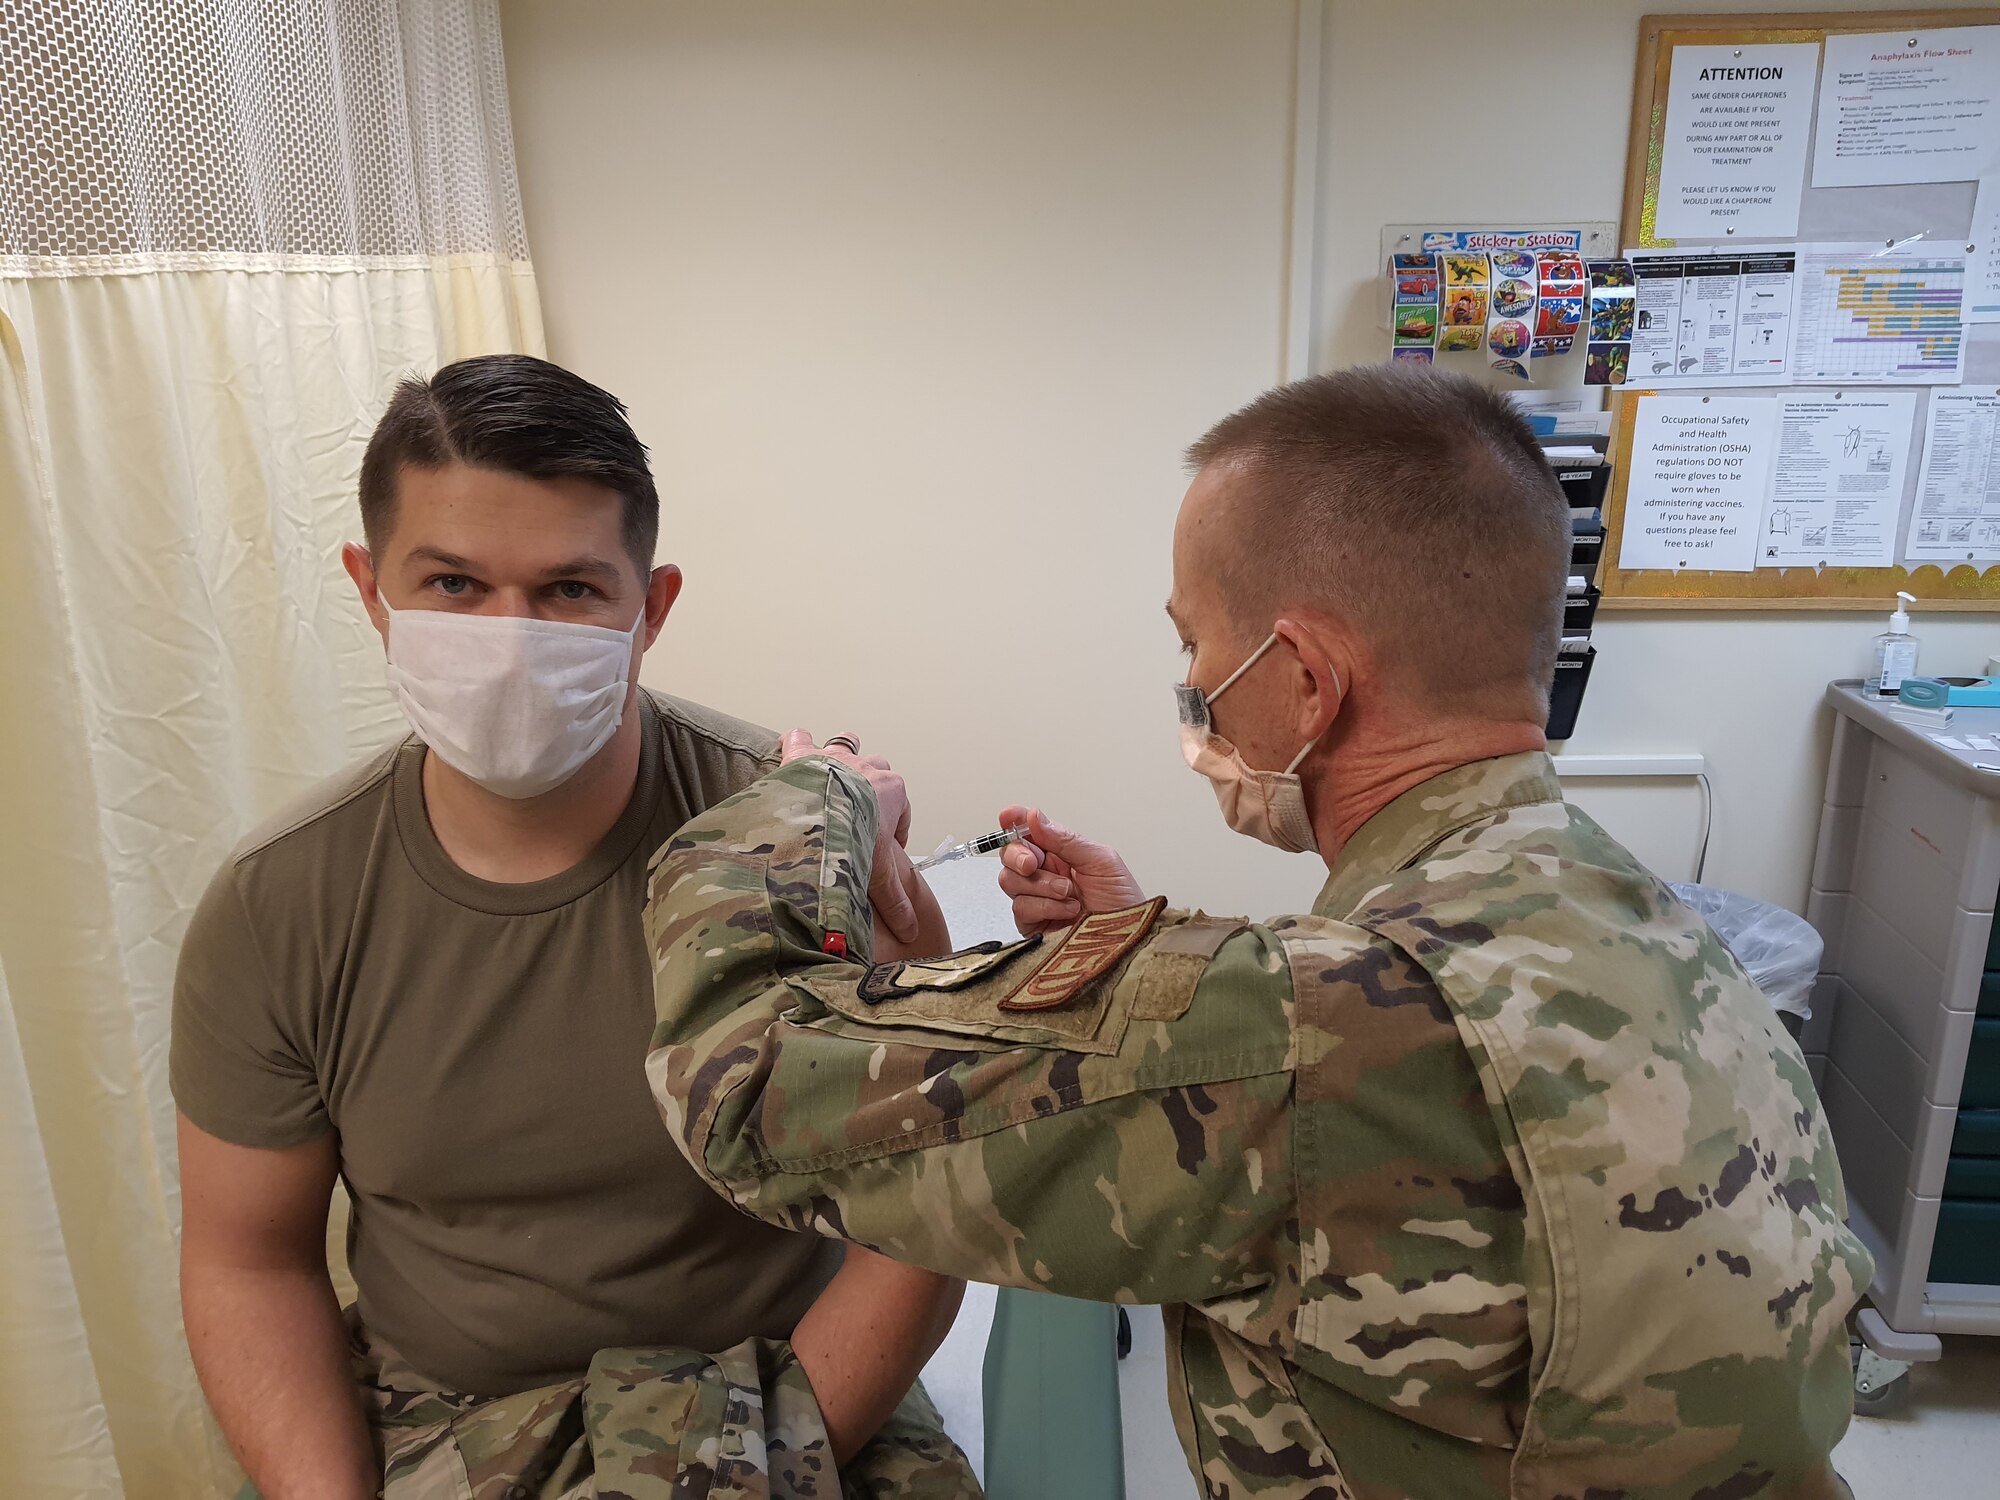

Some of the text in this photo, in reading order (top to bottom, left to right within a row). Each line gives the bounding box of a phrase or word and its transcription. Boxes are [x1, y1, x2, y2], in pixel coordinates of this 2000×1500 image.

[1871, 48, 1972, 62] Anaphylaxis Flow Sheet
[1699, 67, 1783, 80] ATTENTION
[1469, 234, 1573, 248] Sticker Station
[1475, 300, 1481, 310] 3
[1500, 300, 1532, 314] AWESOME!
[1472, 332, 1480, 341] 3
[1661, 416, 1750, 426] Occupational Safety
[1679, 430, 1727, 438] and Health
[1652, 443, 1752, 454] Administration (OSHA)
[1656, 458, 1744, 467] regulations DO NOT
[1654, 471, 1686, 480] require
[1688, 472, 1716, 481] gloves
[1730, 472, 1742, 480] be
[1696, 485, 1721, 494] when
[1644, 499, 1745, 509] administering vaccines.
[1660, 512, 1726, 522] If you have any
[1645, 526, 1737, 535] questions please feel
[1664, 540, 1714, 548] free to ask!
[1027, 909, 1147, 996] MED
